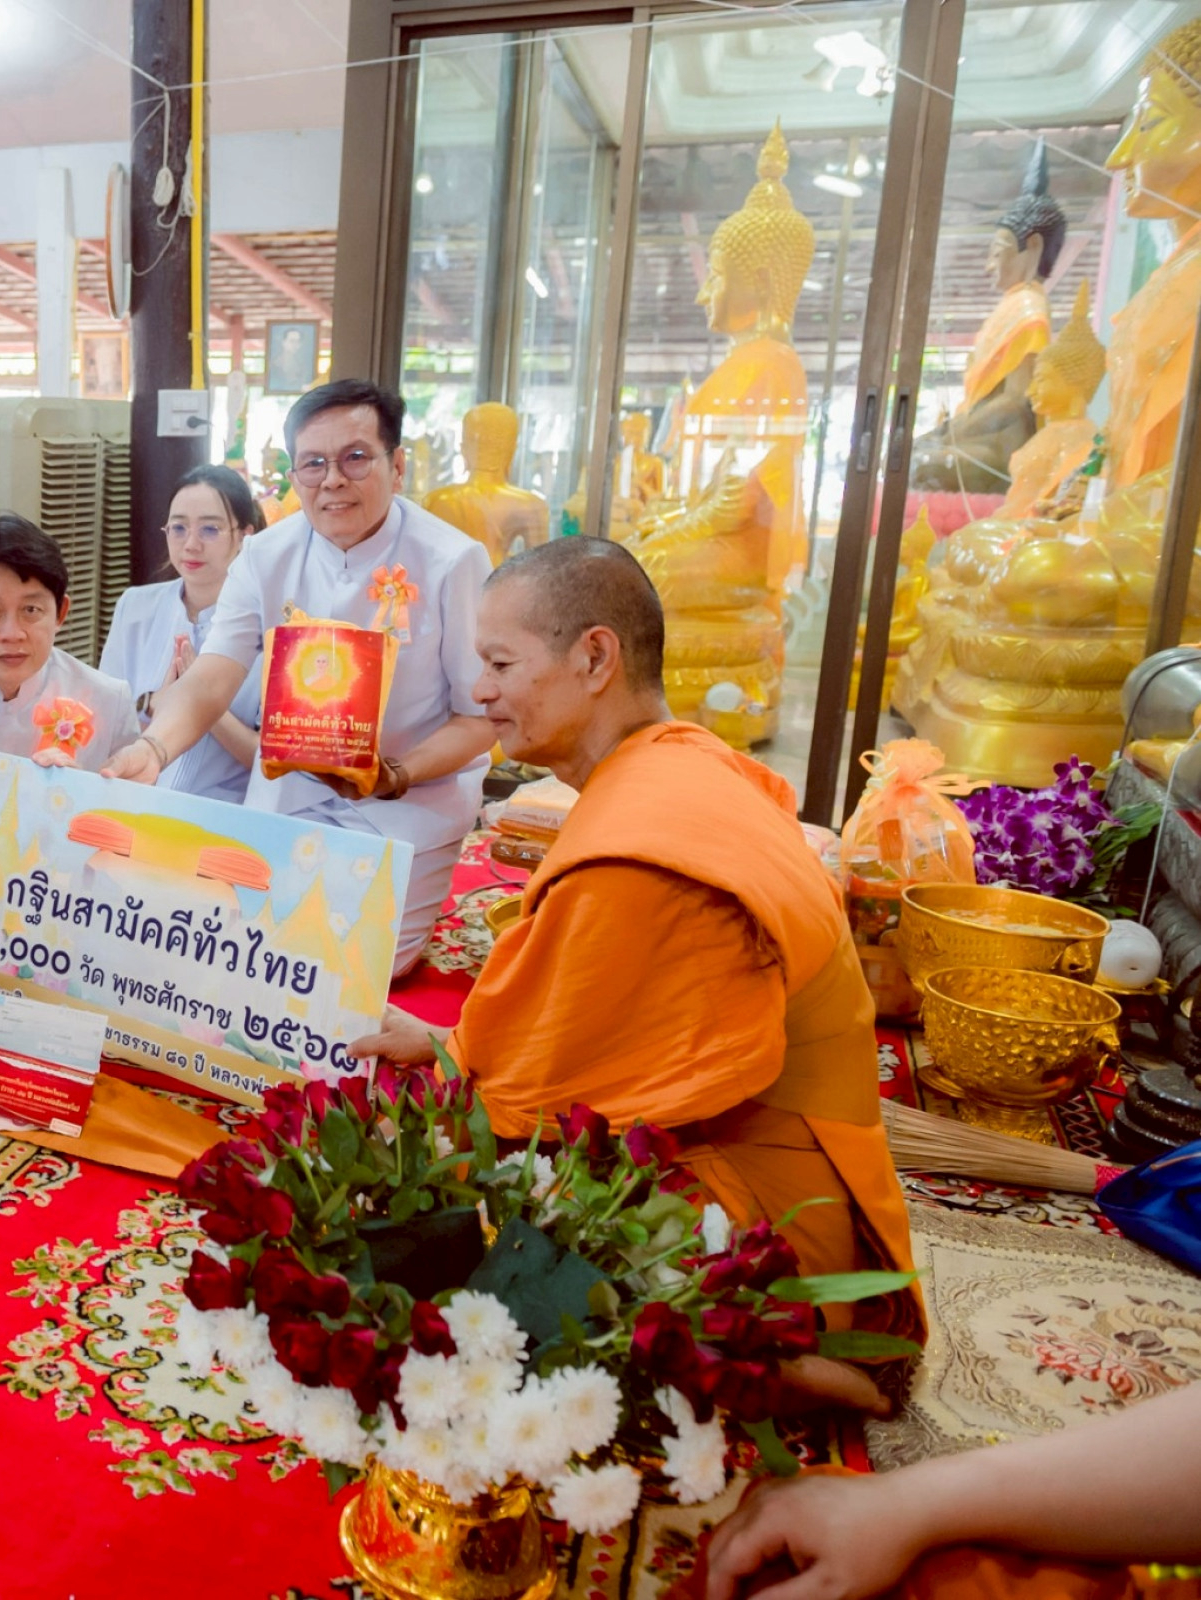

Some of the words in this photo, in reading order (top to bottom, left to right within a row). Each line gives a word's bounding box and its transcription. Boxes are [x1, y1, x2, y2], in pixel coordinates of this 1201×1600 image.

[6, 869, 318, 995] กฐินสามัคคีทั่วไทย
[80, 954, 104, 988] วัด
[112, 973, 233, 1030] พุทธศักราช
[243, 1005, 359, 1073] ๒๕๖๘
[165, 1050, 188, 1068] ๘๑
[194, 1053, 205, 1073] ปี
